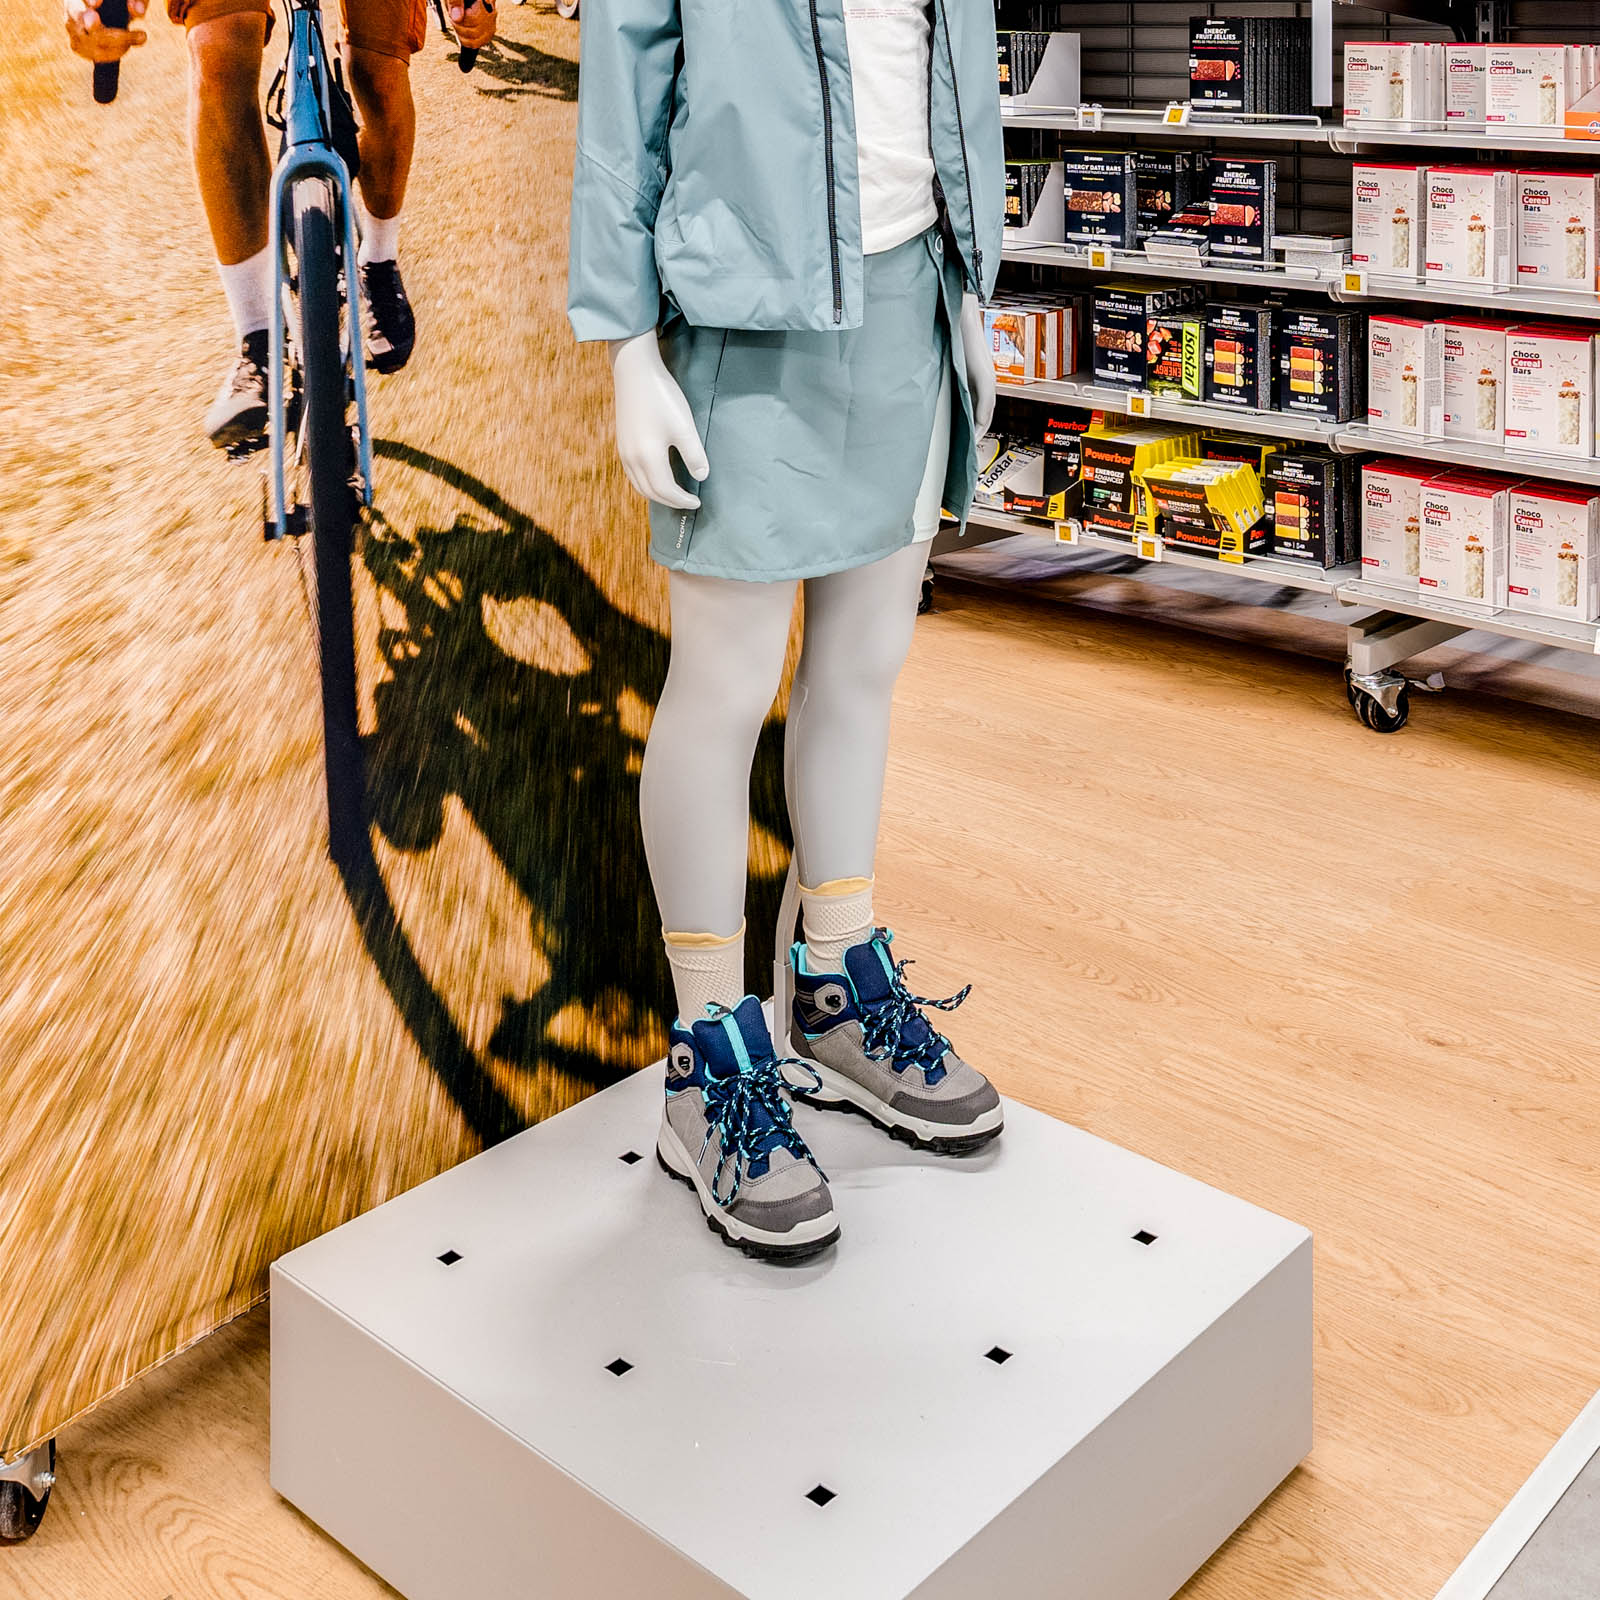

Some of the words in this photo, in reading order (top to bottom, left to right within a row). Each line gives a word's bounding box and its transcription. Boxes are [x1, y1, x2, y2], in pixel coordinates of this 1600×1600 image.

[1432, 194, 1454, 202] Cereal
[1523, 196, 1549, 204] Cereal
[1373, 334, 1390, 342] Choco
[1372, 342, 1391, 351] Cereal
[1445, 347, 1463, 355] ereal
[1184, 328, 1196, 388] isostar
[1373, 350, 1384, 358] Bars
[1512, 359, 1540, 368] Cereal
[1048, 418, 1087, 431] Powerbar
[1085, 448, 1134, 465] Powerbar
[982, 456, 1014, 488] isostar
[1151, 485, 1205, 499] Powerbar
[1368, 484, 1389, 493] Choco
[1013, 497, 1045, 507] Powerbar
[1367, 492, 1390, 502] Cereal
[1368, 500, 1383, 508] Bars
[1425, 501, 1448, 511] Choco
[1425, 509, 1449, 520] Cereal
[1516, 508, 1541, 518] Choco
[1094, 515, 1134, 529] Powerbar
[1425, 518, 1441, 526] Bars
[1515, 517, 1542, 527] Cereal
[675, 515, 687, 549] QUECHUA
[1516, 525, 1533, 533] Bars
[1176, 531, 1219, 545] Powerbar
